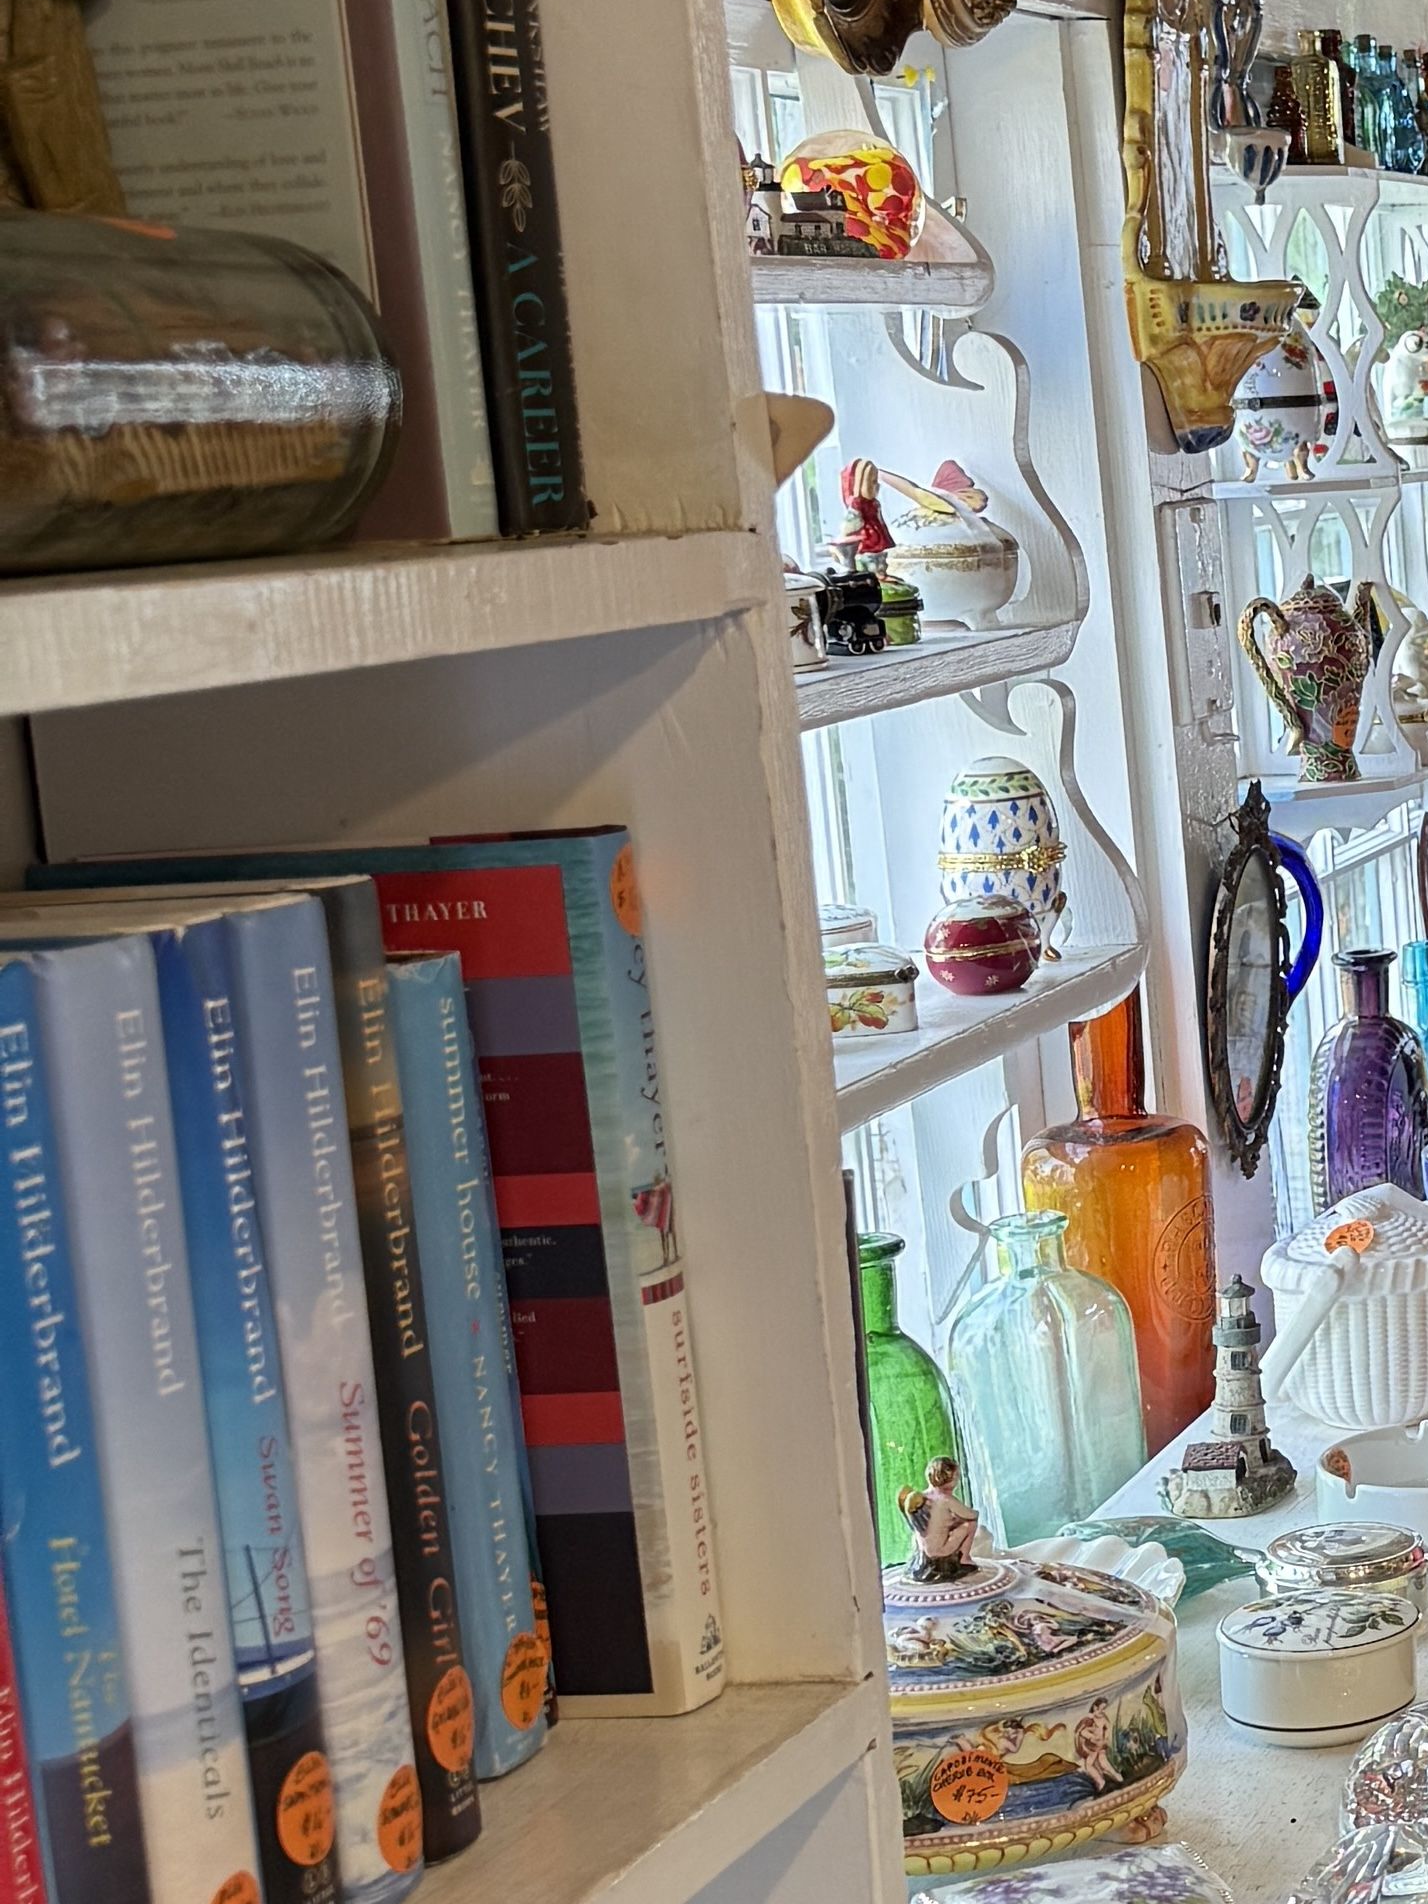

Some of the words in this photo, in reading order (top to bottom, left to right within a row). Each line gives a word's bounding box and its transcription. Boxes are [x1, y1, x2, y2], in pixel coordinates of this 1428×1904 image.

[507, 241, 540, 276] A
[512, 292, 566, 508] CAREER
[386, 899, 490, 925] THAYER
[115, 1007, 148, 1099] Elin
[203, 996, 235, 1093] Elin
[291, 964, 319, 1050] Elin
[357, 976, 390, 1067] Elin
[0, 1020, 34, 1127] Elin
[303, 1062, 356, 1335] Hilderbrand
[371, 1078, 424, 1360] Hilderbrand
[10, 1144, 82, 1472] Hilderbrand
[125, 1114, 187, 1399] Hilderbrand
[217, 1107, 276, 1406] Hilderbrand
[439, 995, 471, 1167] summer
[457, 1177, 484, 1303] house
[471, 1354, 499, 1478] NANCY
[489, 1497, 518, 1634] THAYER
[258, 1434, 285, 1537] Swan
[339, 1379, 376, 1547] Summer
[406, 1398, 441, 1558] Golden
[670, 1309, 697, 1463] surfside
[688, 1473, 712, 1599] sisters
[176, 1537, 208, 1616] The
[272, 1544, 297, 1639] Song
[351, 1554, 379, 1592] of
[426, 1576, 459, 1667] Girl
[184, 1625, 225, 1822] Identicals
